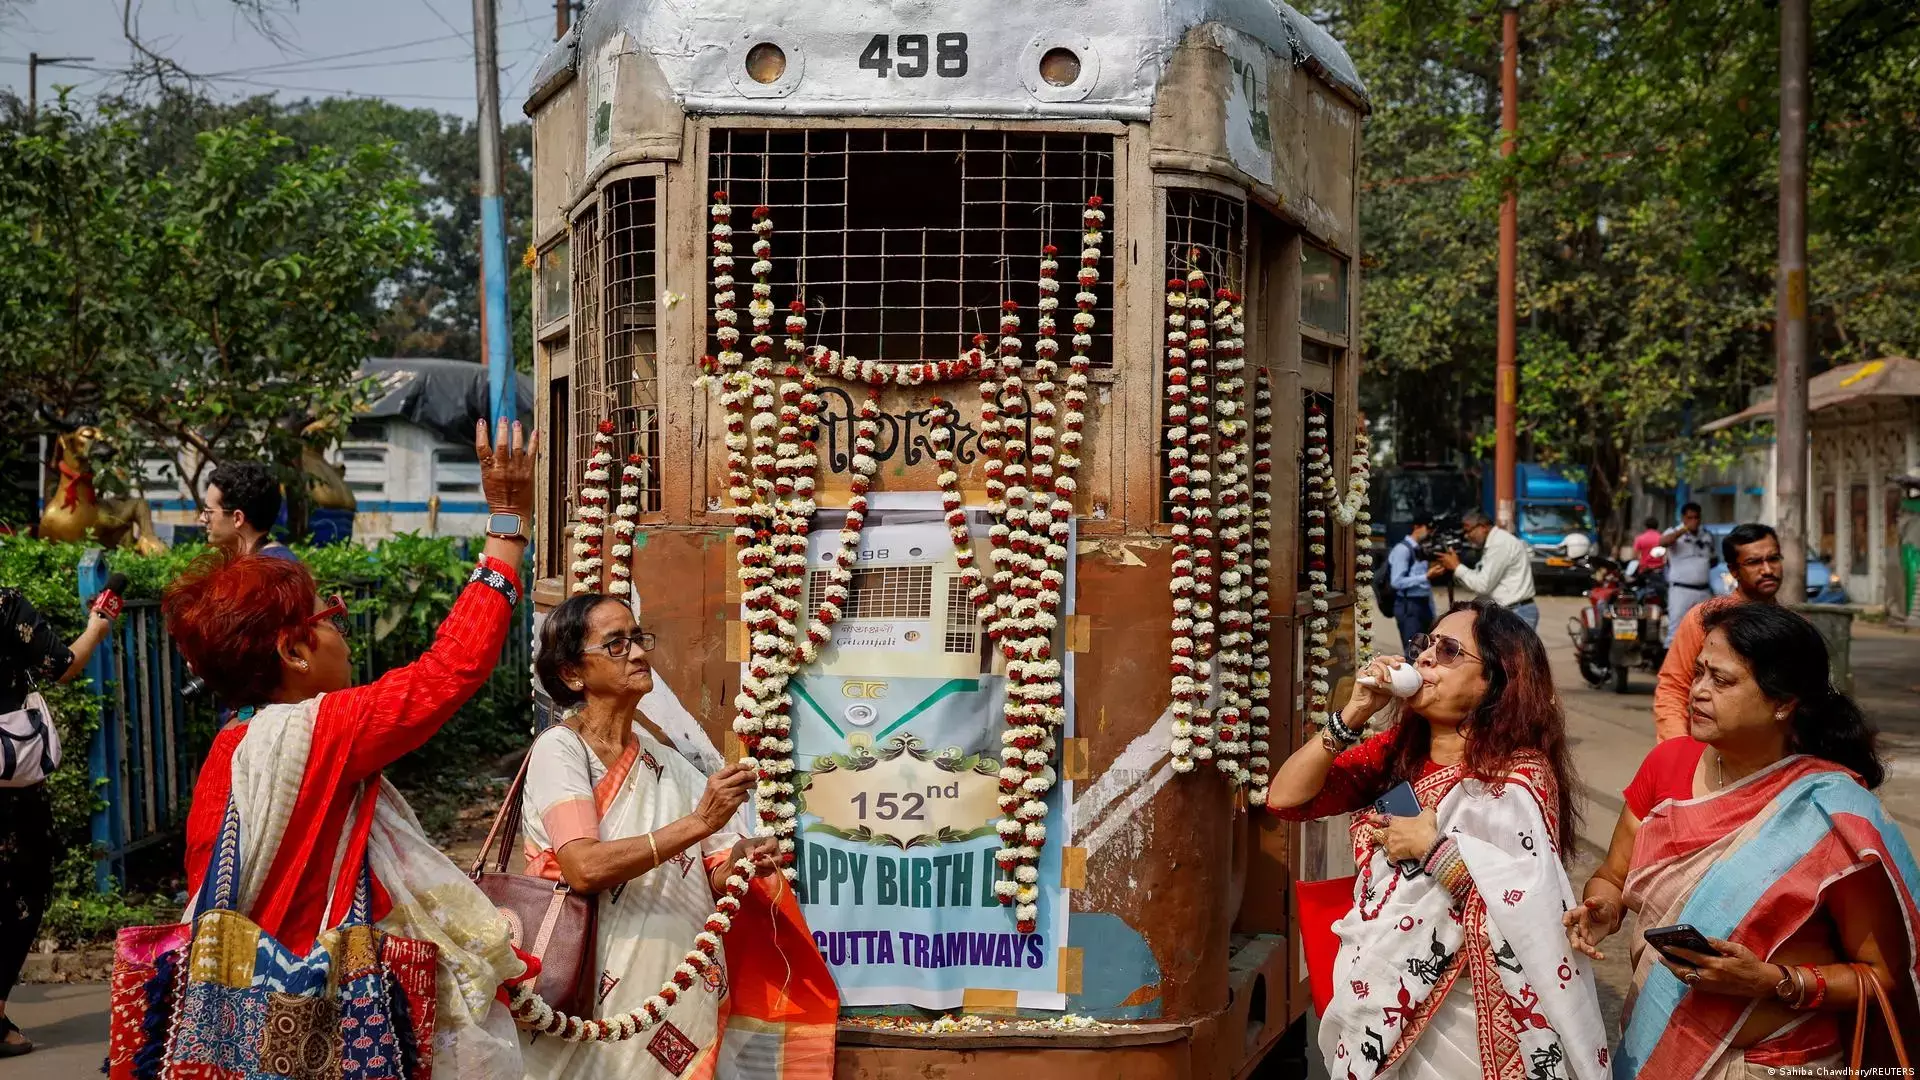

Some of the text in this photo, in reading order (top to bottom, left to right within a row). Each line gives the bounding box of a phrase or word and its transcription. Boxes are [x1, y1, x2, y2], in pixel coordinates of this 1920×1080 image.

[859, 32, 968, 78] 498
[855, 549, 889, 561] 98
[793, 837, 868, 906] APPY
[876, 851, 974, 908] BIRTH
[811, 930, 1044, 969] CUTTA TRAMWAYS
